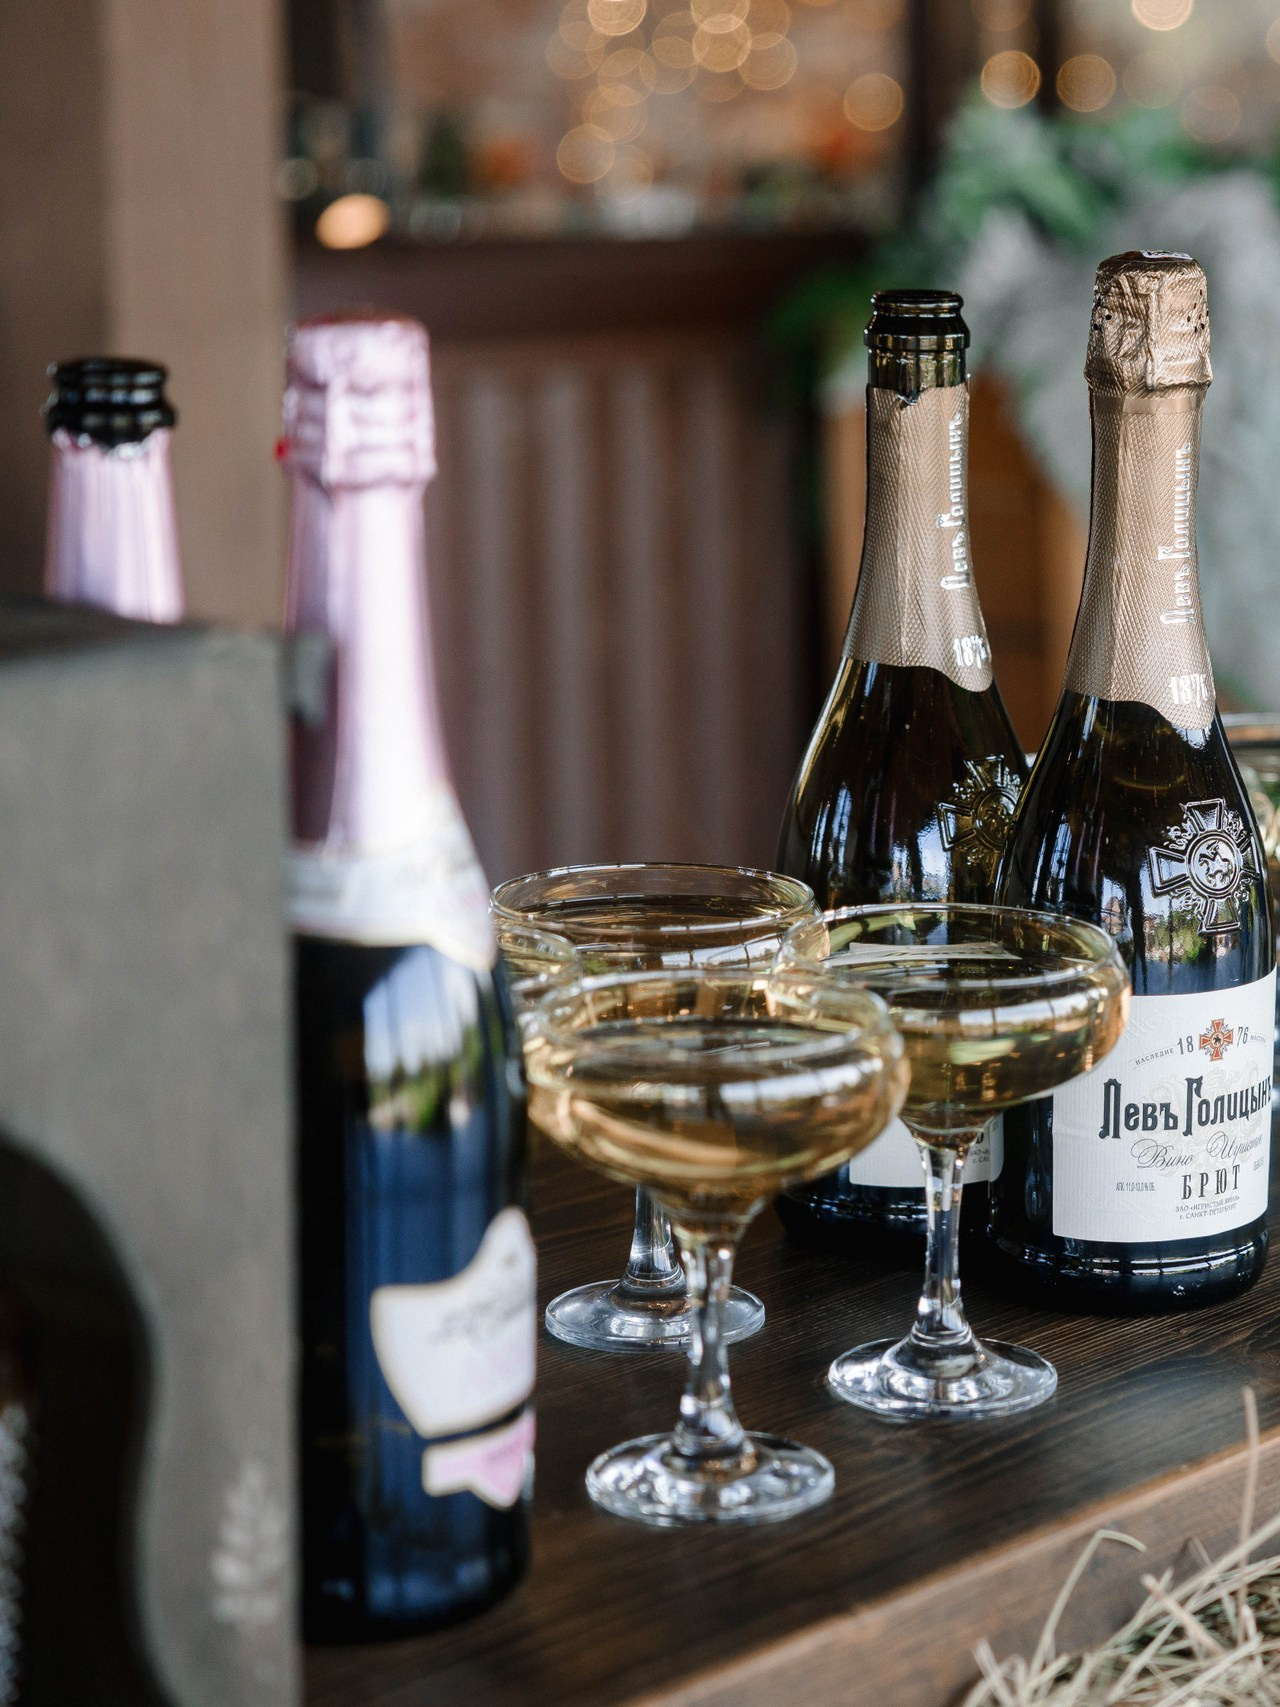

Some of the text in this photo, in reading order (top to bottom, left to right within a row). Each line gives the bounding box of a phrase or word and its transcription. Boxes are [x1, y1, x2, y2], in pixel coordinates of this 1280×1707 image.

[1134, 1047, 1175, 1066] НАСЛЕДИЕ
[1177, 1035, 1194, 1055] 18
[1237, 1026, 1249, 1048] 76
[1098, 1078, 1179, 1139] Левъ
[1131, 1138, 1193, 1171] Вино
[1181, 1164, 1241, 1200] БРЮТ
[1185, 1203, 1237, 1219] САНКТ-ПЕТЕРБУРГ
